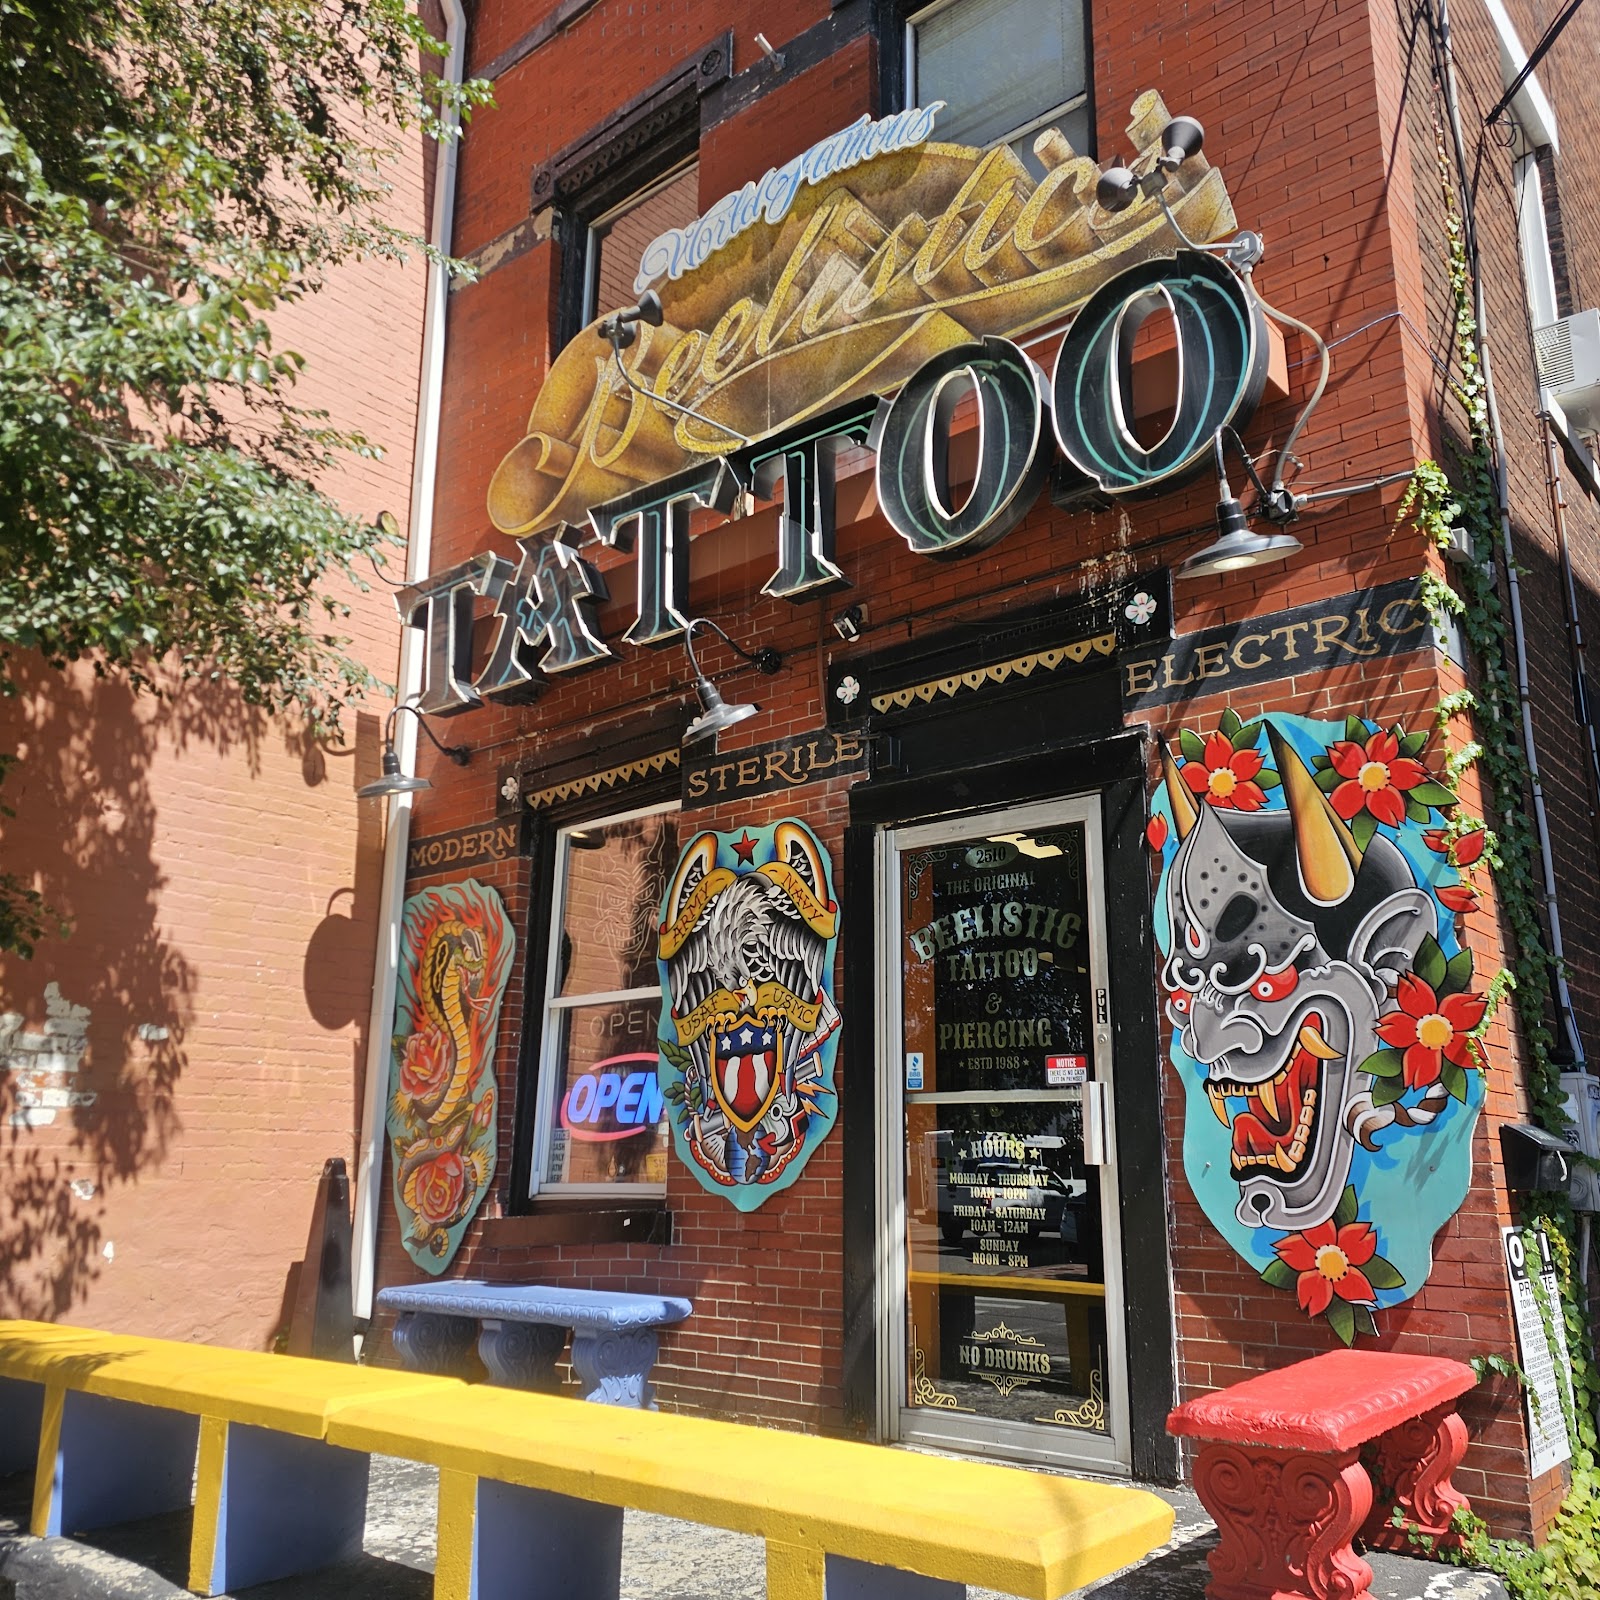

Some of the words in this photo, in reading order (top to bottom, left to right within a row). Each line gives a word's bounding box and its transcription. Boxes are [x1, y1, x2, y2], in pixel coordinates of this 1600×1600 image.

[634, 168, 778, 294] World
[765, 101, 947, 224] Famous
[394, 249, 1266, 717] TATTOO
[1126, 599, 1424, 697] ELECTRIC
[688, 730, 863, 798] STERILE
[410, 824, 517, 868] MODERN
[976, 847, 1006, 865] 2510
[781, 872, 823, 922] NAVY
[946, 880, 970, 896] THE
[974, 871, 1036, 892] ORIGINAL
[673, 881, 709, 947] ARMY
[909, 902, 1082, 964] BEELISTIC
[947, 947, 1039, 982] TATTOO
[680, 993, 720, 1037] USAF
[773, 988, 816, 1024] USMC
[1097, 989, 1107, 1023] PULL
[939, 1018, 1052, 1051] PIERCING
[996, 1056, 1020, 1069] 1988
[1056, 1057, 1077, 1068] NOTICE
[567, 1072, 664, 1124] OPEN
[970, 1139, 1026, 1160] HOURS
[949, 1172, 989, 1185] MONDAY
[997, 1173, 1049, 1187] THURSDAY
[970, 1186, 995, 1199] 10AM
[1003, 1187, 1028, 1200] 10PM
[953, 1205, 987, 1217] FRIDAY
[996, 1206, 1046, 1220] SATURDAY
[970, 1219, 996, 1232] 10AM
[1003, 1220, 1029, 1234] 12AM
[972, 1252, 1000, 1266] NOON
[980, 1238, 1019, 1253] SUNDAY
[959, 1344, 980, 1367] NO
[984, 1346, 1051, 1375] DRUNKS
